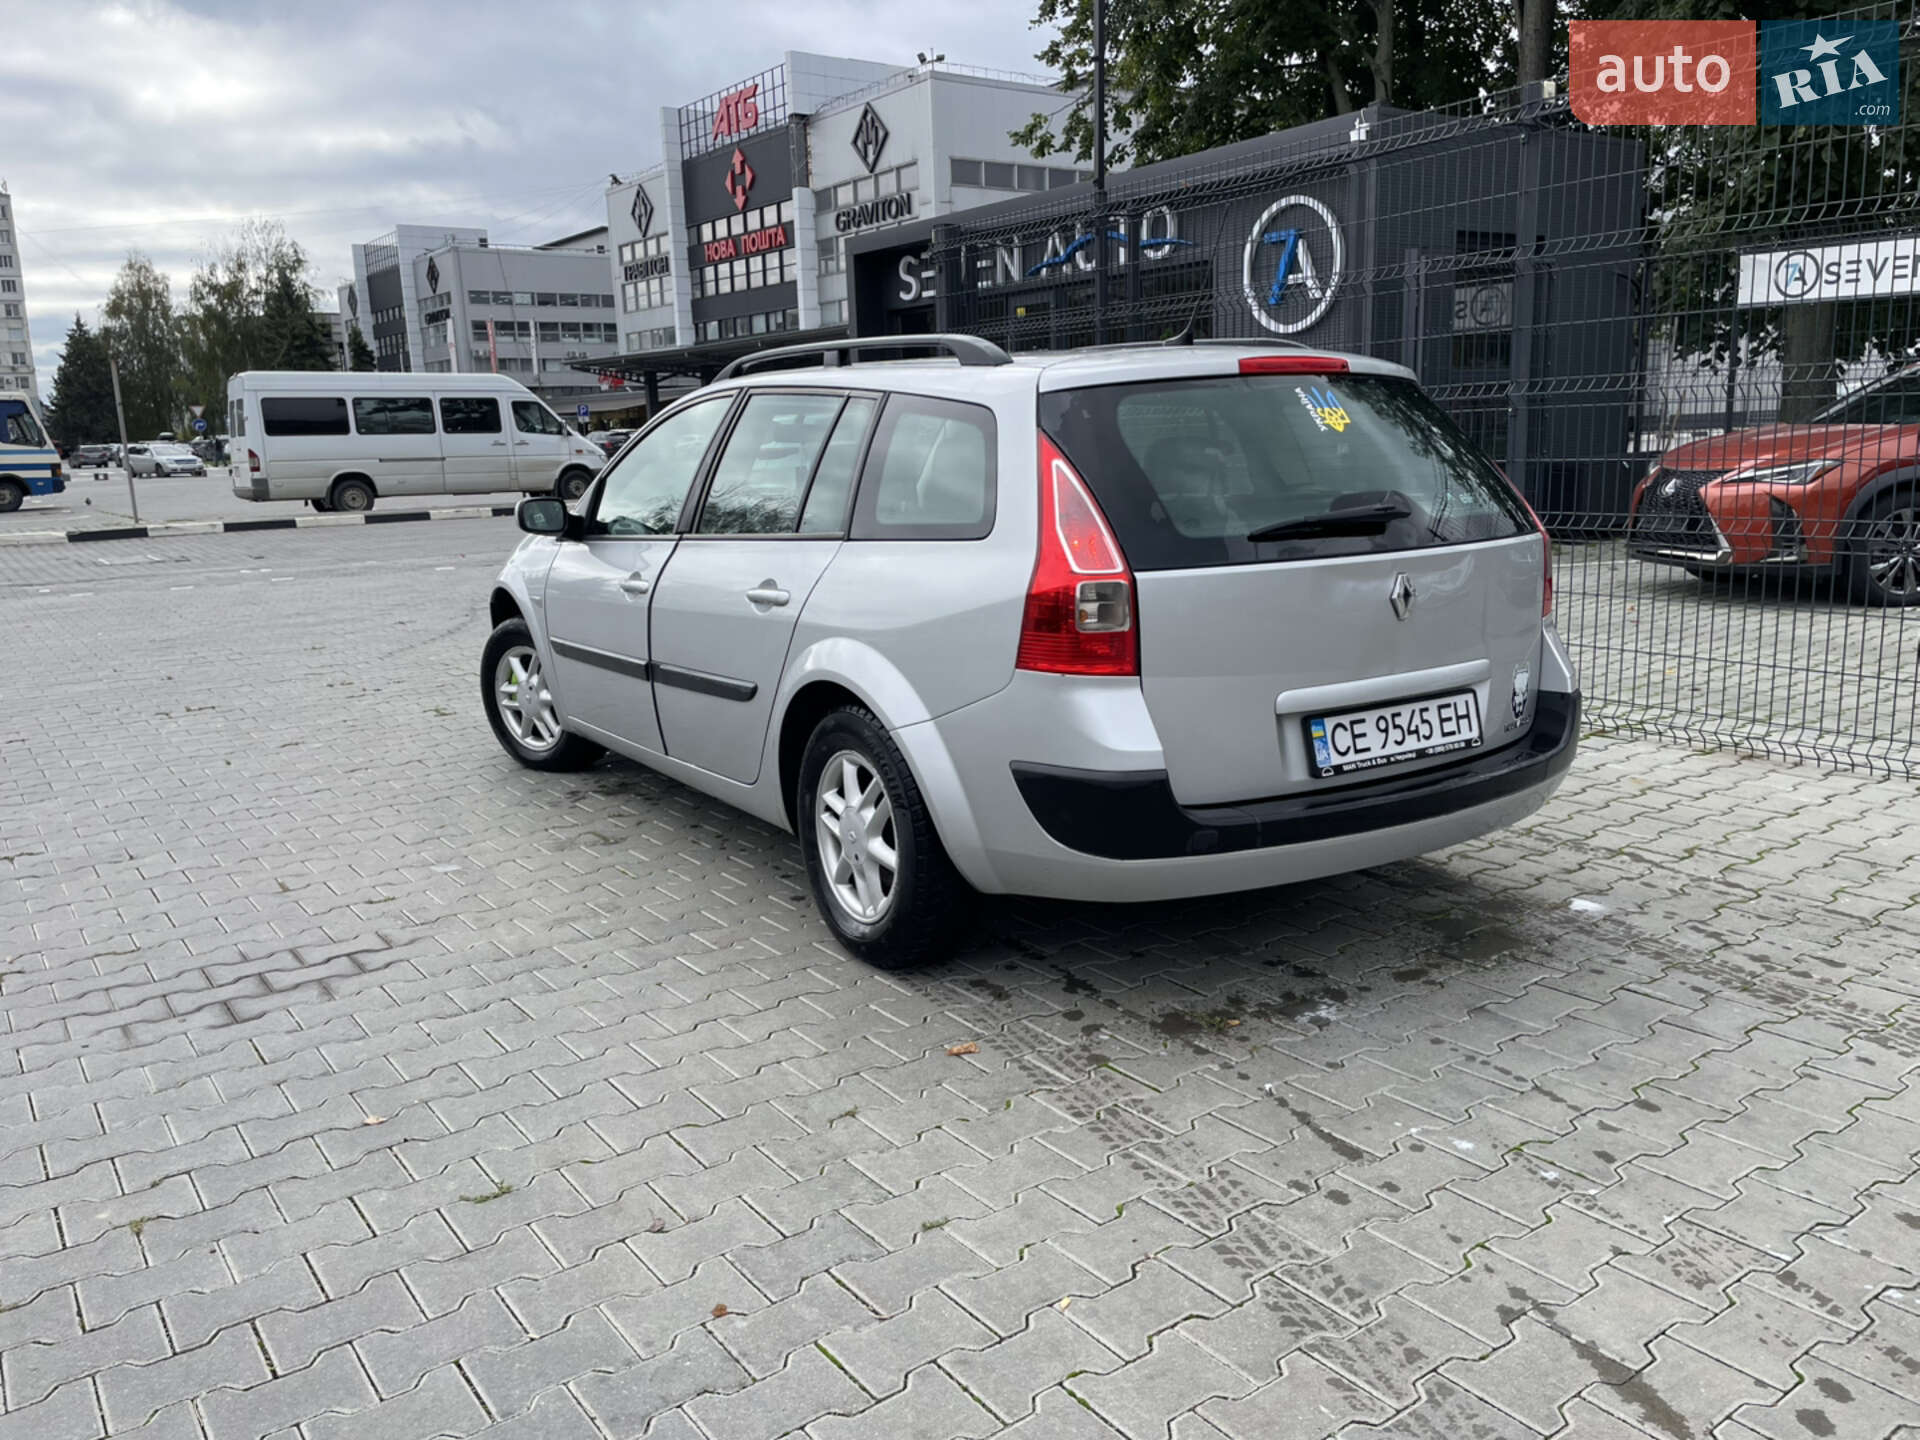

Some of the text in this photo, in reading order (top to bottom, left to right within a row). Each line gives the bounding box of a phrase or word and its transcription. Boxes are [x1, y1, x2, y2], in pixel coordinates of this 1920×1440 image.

[712, 84, 759, 141] АТБ
[835, 192, 912, 232] GRAVITON
[704, 224, 787, 264] НОВА ПОШТА
[899, 234, 1024, 301] SEEN
[1331, 718, 1371, 757] CE
[1375, 707, 1433, 750] 9545
[1437, 700, 1473, 738] EH
